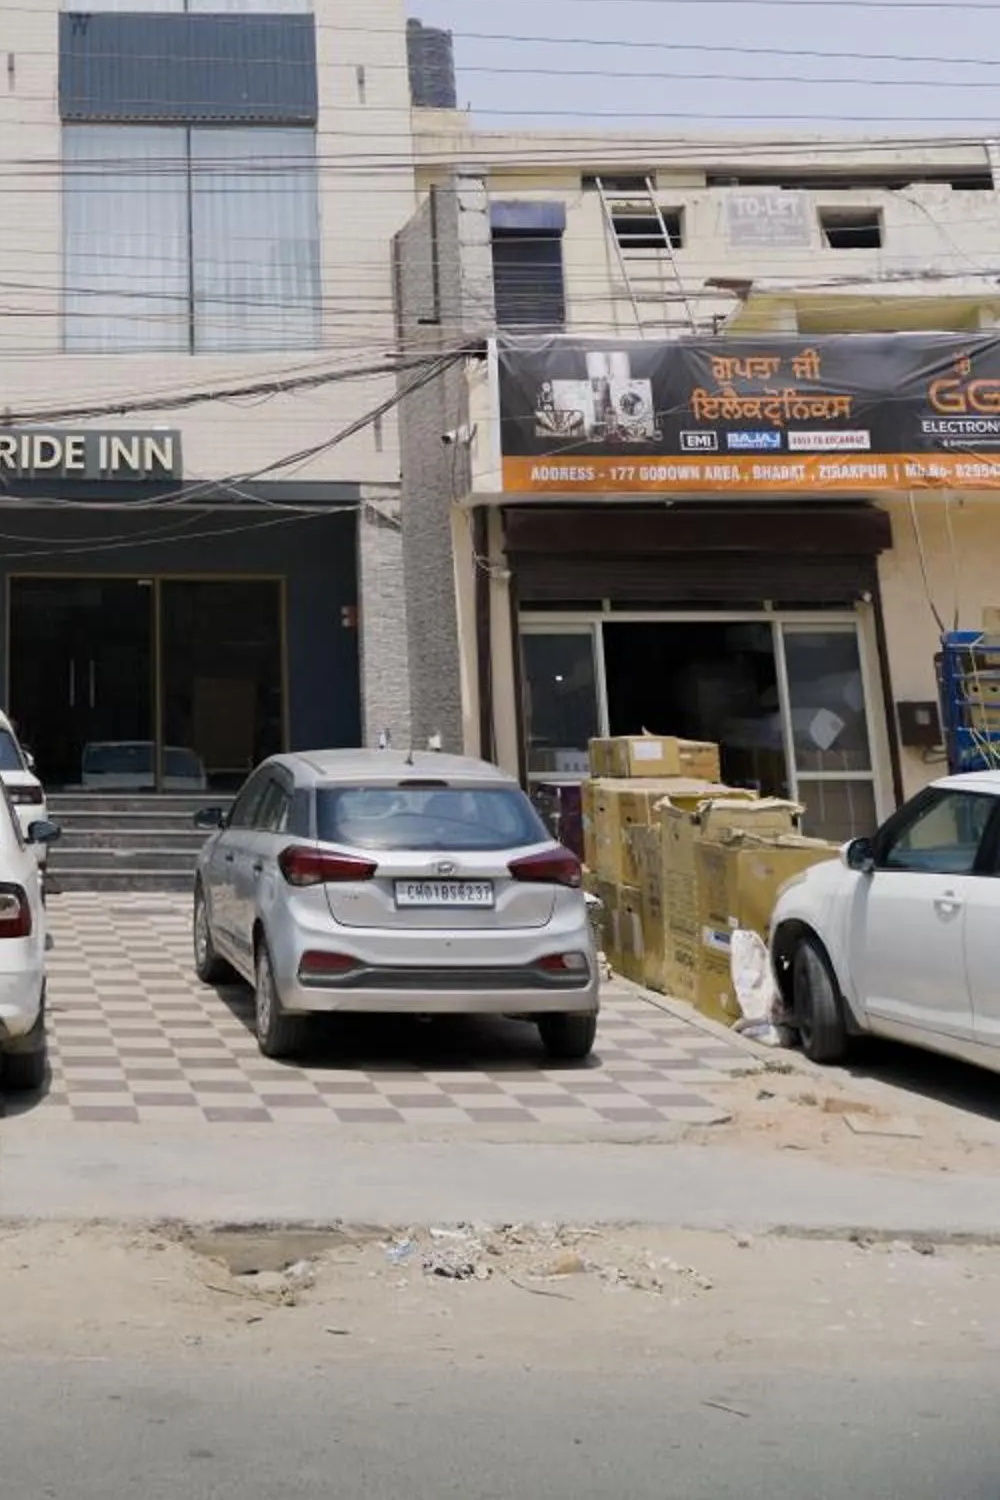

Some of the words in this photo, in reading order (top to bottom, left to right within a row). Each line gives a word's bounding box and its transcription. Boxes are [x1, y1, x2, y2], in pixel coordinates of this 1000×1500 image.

[921, 419, 1000, 433] ELECTRON
[686, 435, 712, 447] EMI
[100, 436, 173, 470] INN
[531, 466, 595, 481] ADDRESS
[609, 467, 634, 481] 177
[639, 466, 699, 481] GODOWN
[704, 465, 740, 481] AREA
